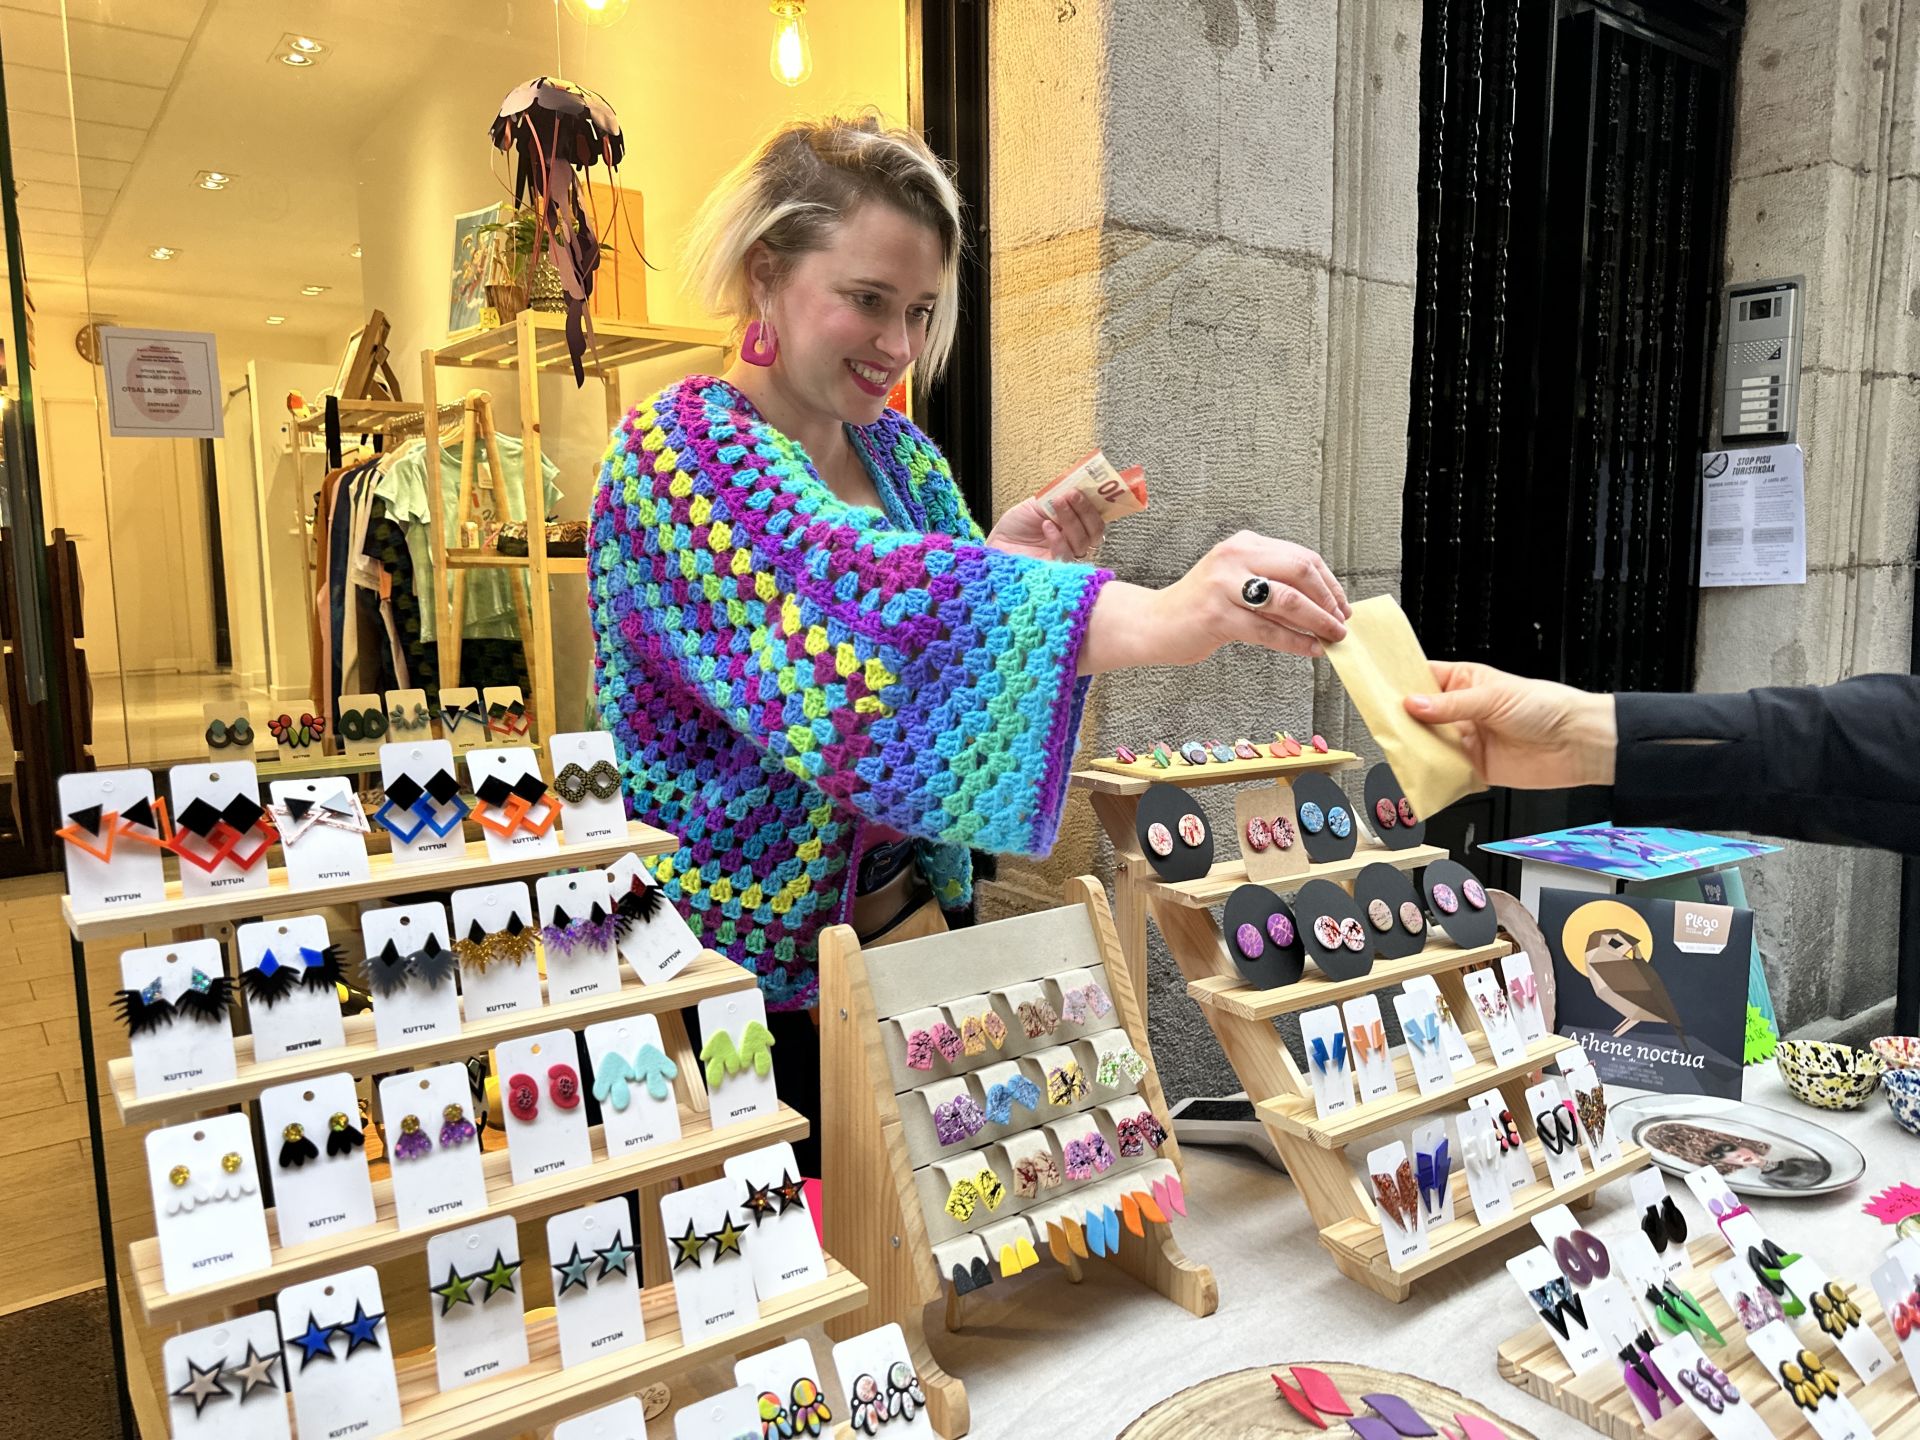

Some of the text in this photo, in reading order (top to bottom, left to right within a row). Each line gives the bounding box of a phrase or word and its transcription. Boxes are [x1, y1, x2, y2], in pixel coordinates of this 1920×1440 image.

[122, 386, 152, 394] OTSAILA
[169, 387, 202, 396] FEBRERO
[1737, 455, 1771, 466] STOP PISU
[1732, 464, 1776, 476] TURISTIKOAK
[1097, 480, 1125, 503] 10
[513, 834, 541, 844] KUTTUN
[418, 842, 447, 851] KUTTUN
[319, 870, 350, 879] KUTTUN
[211, 876, 244, 887] KUTTUN
[105, 892, 142, 903] KUTTUN
[1685, 913, 1719, 937] Plego
[659, 949, 681, 969] KUTTUN
[570, 984, 598, 995] KUTTUN
[487, 1002, 516, 1012] KUTTUN
[403, 1024, 435, 1034] KUTTUN
[286, 1039, 322, 1051] KUTTUN
[1569, 1032, 1705, 1069] Athene noctua
[164, 1069, 202, 1081] KUTTUN
[730, 1105, 756, 1117] KUTTUN
[1329, 1101, 1344, 1109] KUTTUN
[625, 1134, 653, 1146] KUTTUN
[534, 1160, 565, 1174] KUTTUN
[428, 1200, 462, 1214] KUTTUN
[309, 1214, 345, 1228] KUTTUN
[192, 1252, 233, 1268] KUTTUN
[781, 1266, 808, 1280] KUTTUN
[705, 1310, 734, 1325] KUTTUN
[591, 1331, 623, 1347] KUTTUN
[464, 1361, 499, 1377] KUTTUN
[329, 1421, 368, 1438] KUTTUN
